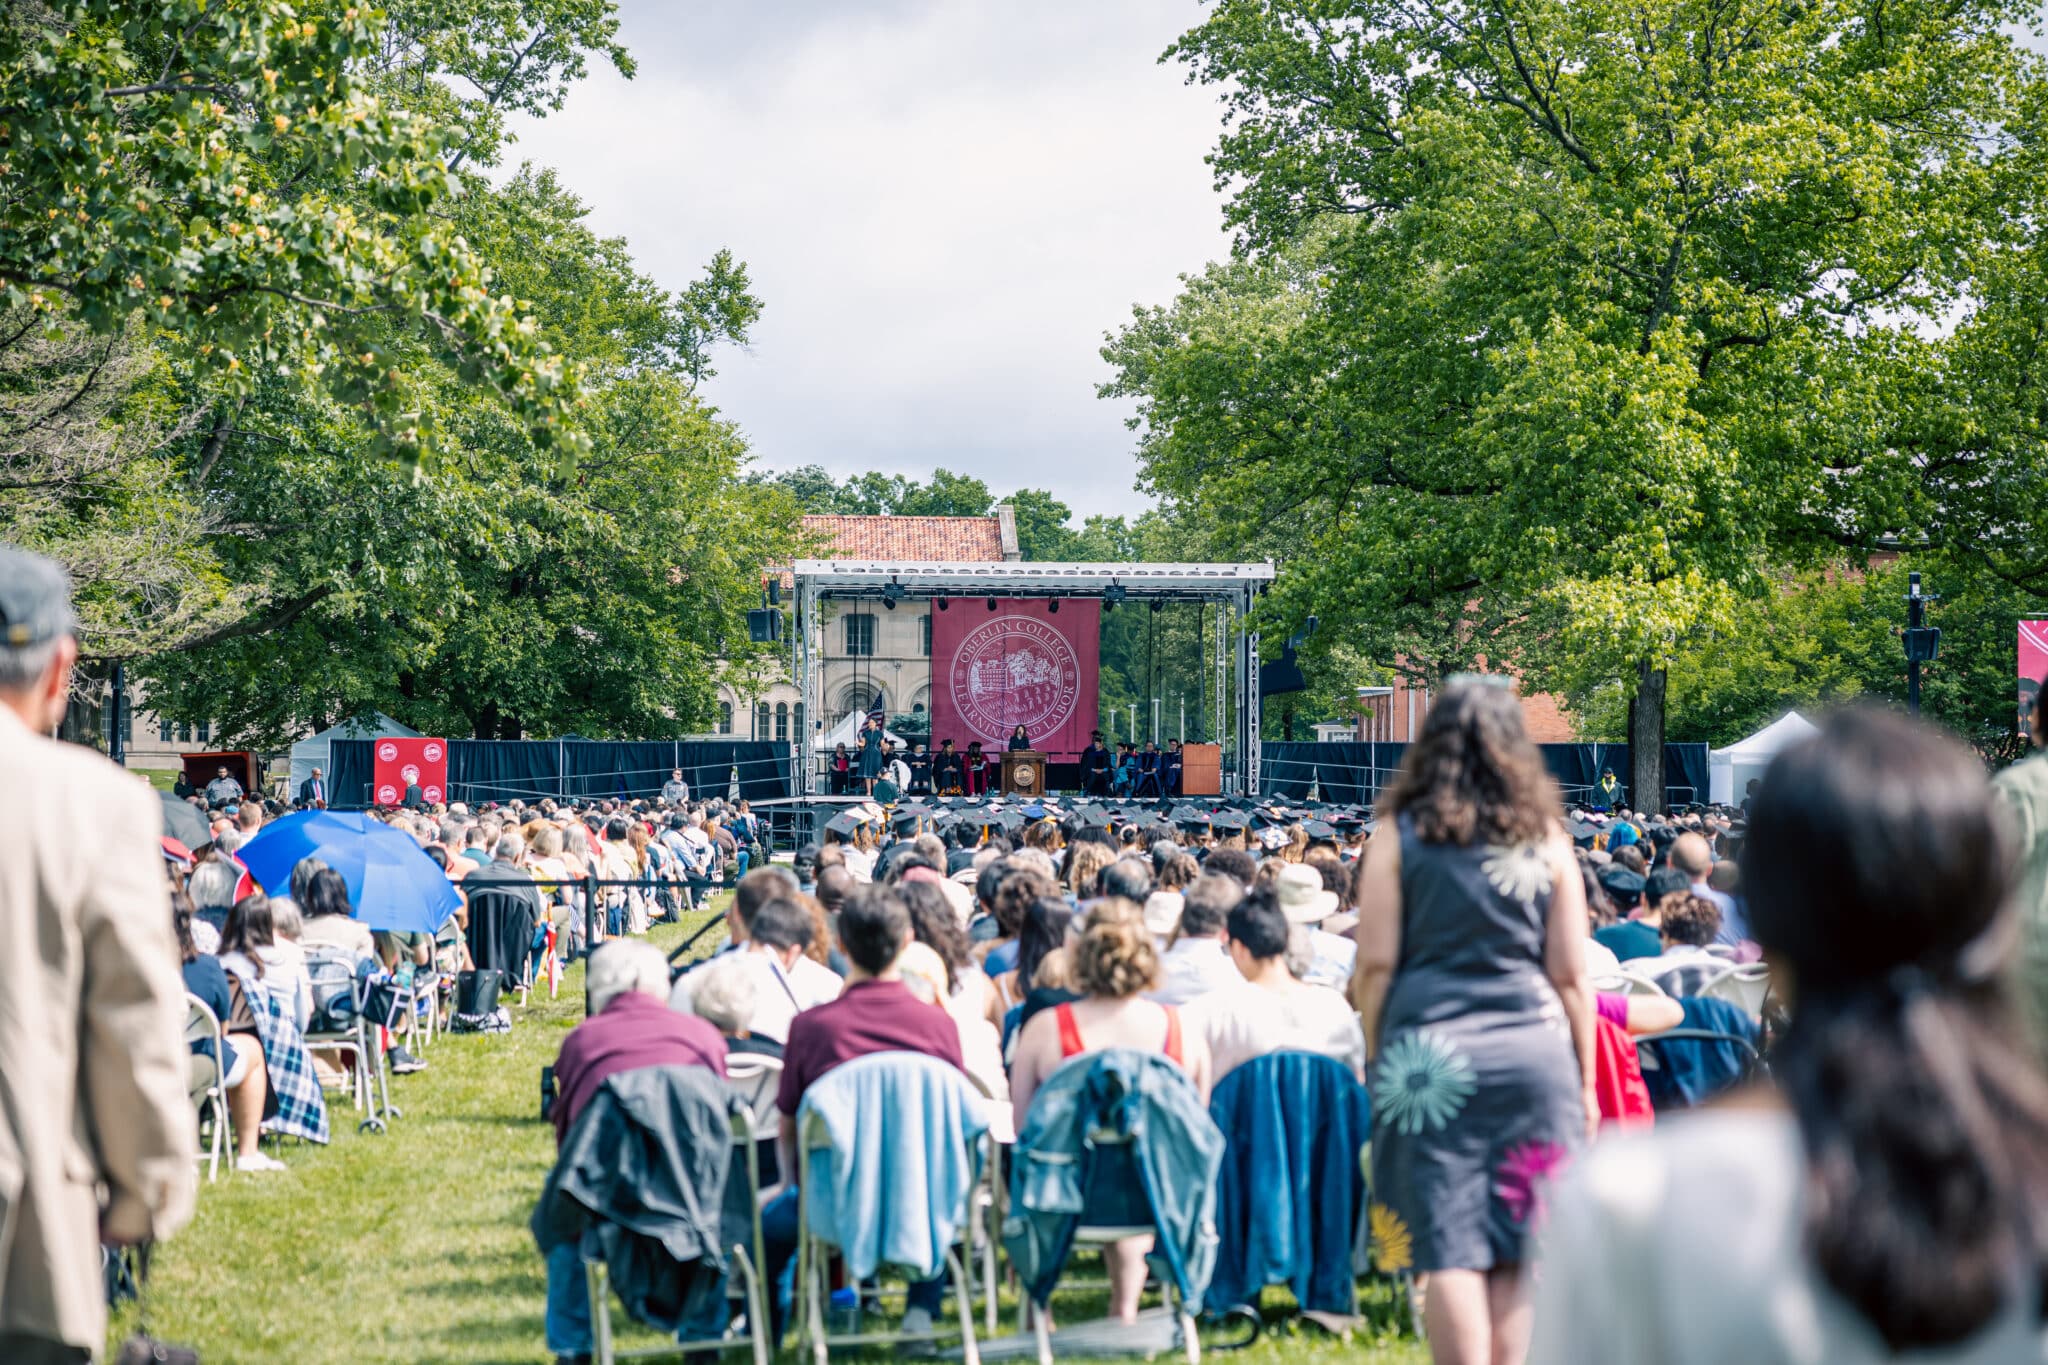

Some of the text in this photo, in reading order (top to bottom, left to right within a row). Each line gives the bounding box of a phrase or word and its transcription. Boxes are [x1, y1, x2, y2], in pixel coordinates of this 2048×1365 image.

[960, 621, 1072, 665] OBERLIN COLLEGE
[956, 684, 1074, 739] LEARNING ND LABOR
